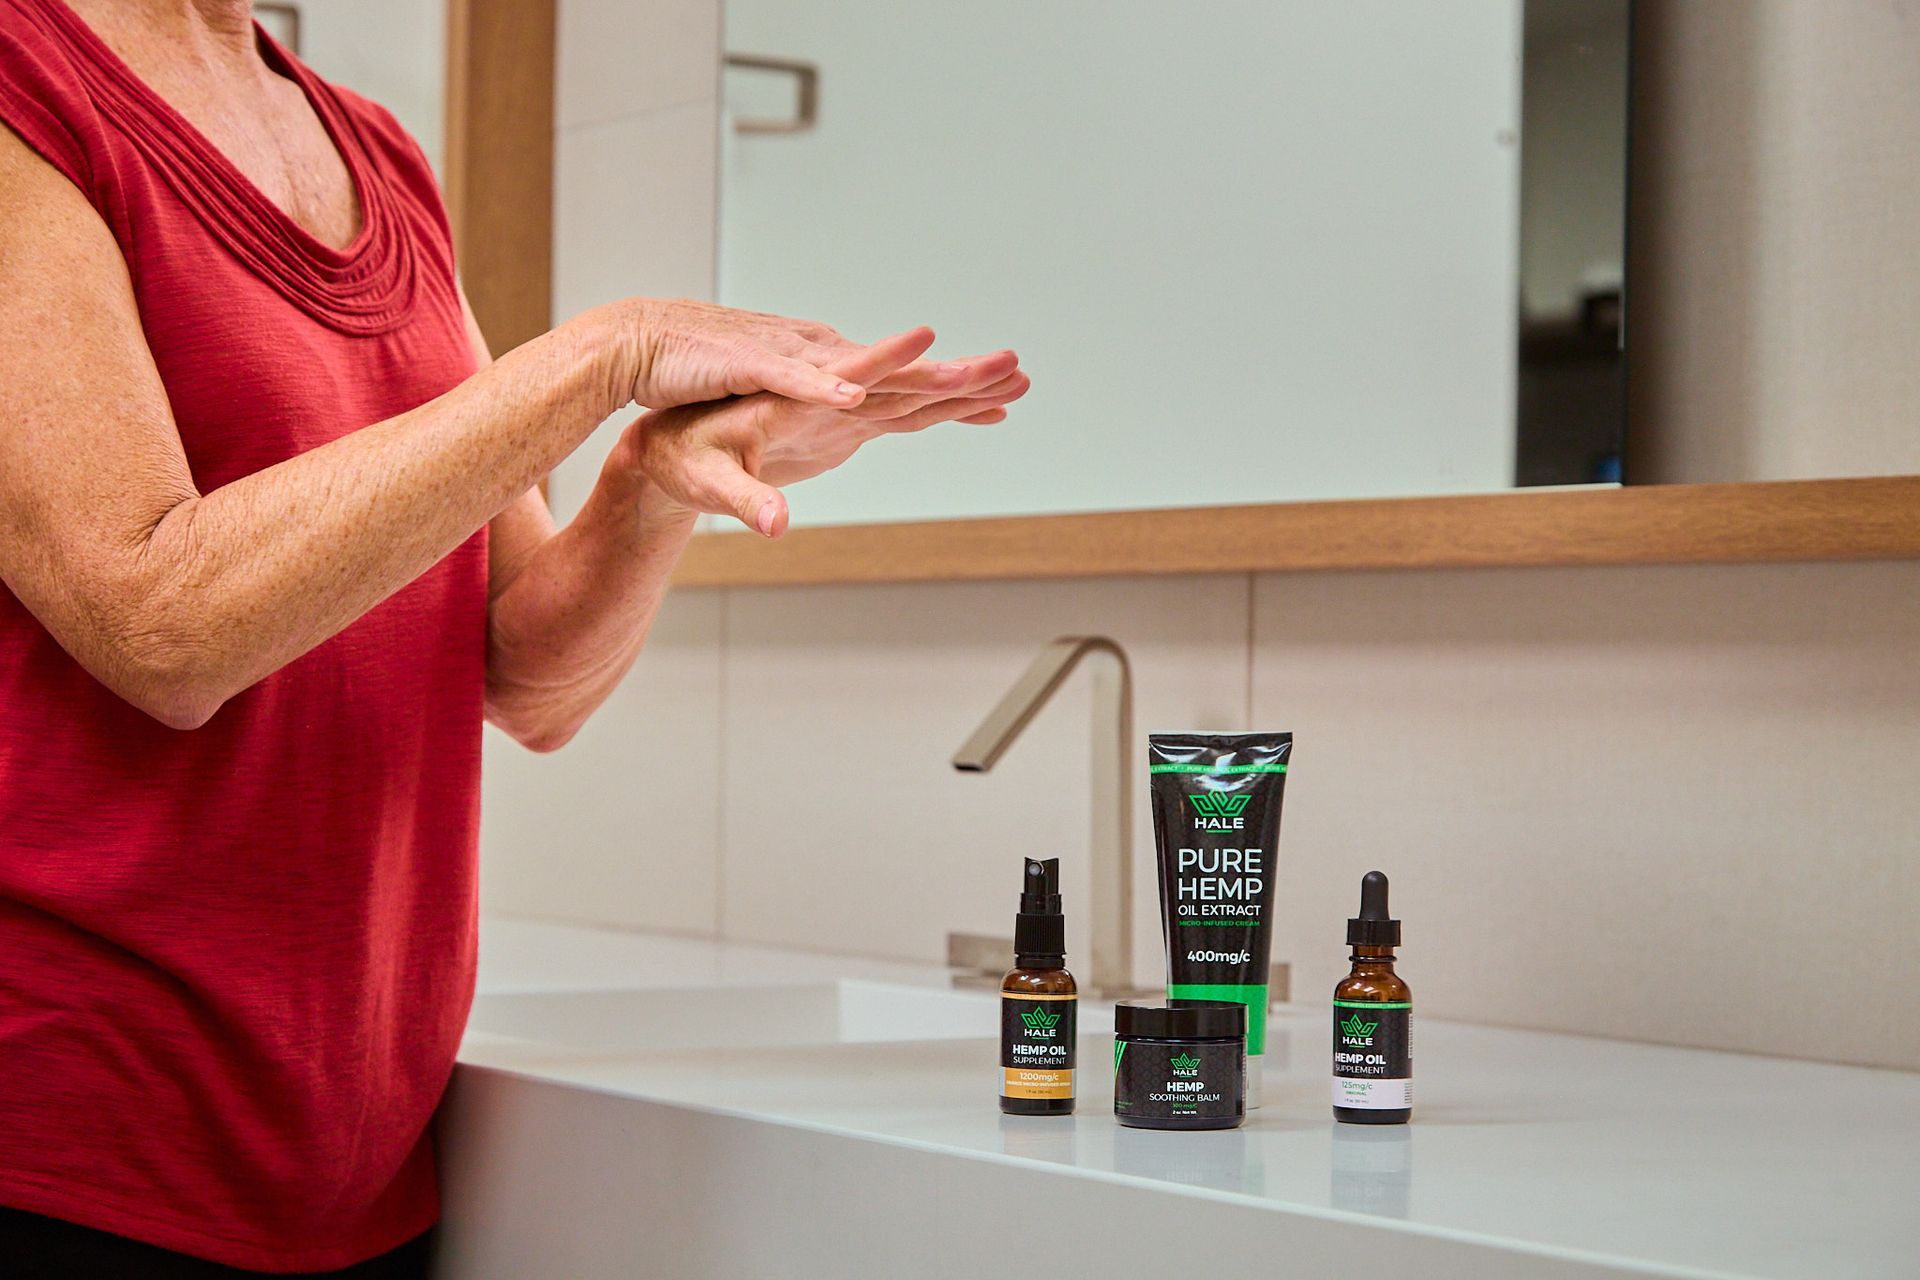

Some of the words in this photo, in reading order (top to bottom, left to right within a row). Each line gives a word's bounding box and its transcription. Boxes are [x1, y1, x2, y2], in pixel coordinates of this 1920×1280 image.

[1194, 817, 1245, 829] HALE
[1178, 848, 1263, 873] PURE
[1178, 877, 1263, 901] HEMP
[1178, 904, 1198, 916] OIL
[1201, 904, 1262, 916] EXTRACT
[1187, 949, 1251, 965] 400mg/c
[1024, 1028, 1057, 1037] HALE
[1342, 1036, 1374, 1046] HALE
[1012, 1044, 1048, 1056] HEMP
[1048, 1045, 1067, 1056] OIL
[1013, 1056, 1065, 1065] SUPPLEMENT
[1334, 1052, 1364, 1065] HEMP
[1365, 1054, 1387, 1065] OIL
[1335, 1064, 1385, 1074] SUPPLEMENT
[1019, 1072, 1060, 1082] 1200mg/c
[1166, 1081, 1205, 1092] HEMP
[1341, 1081, 1373, 1091] 125mg/c
[1149, 1093, 1195, 1101] SOOTHING
[1197, 1093, 1220, 1101] BALM
